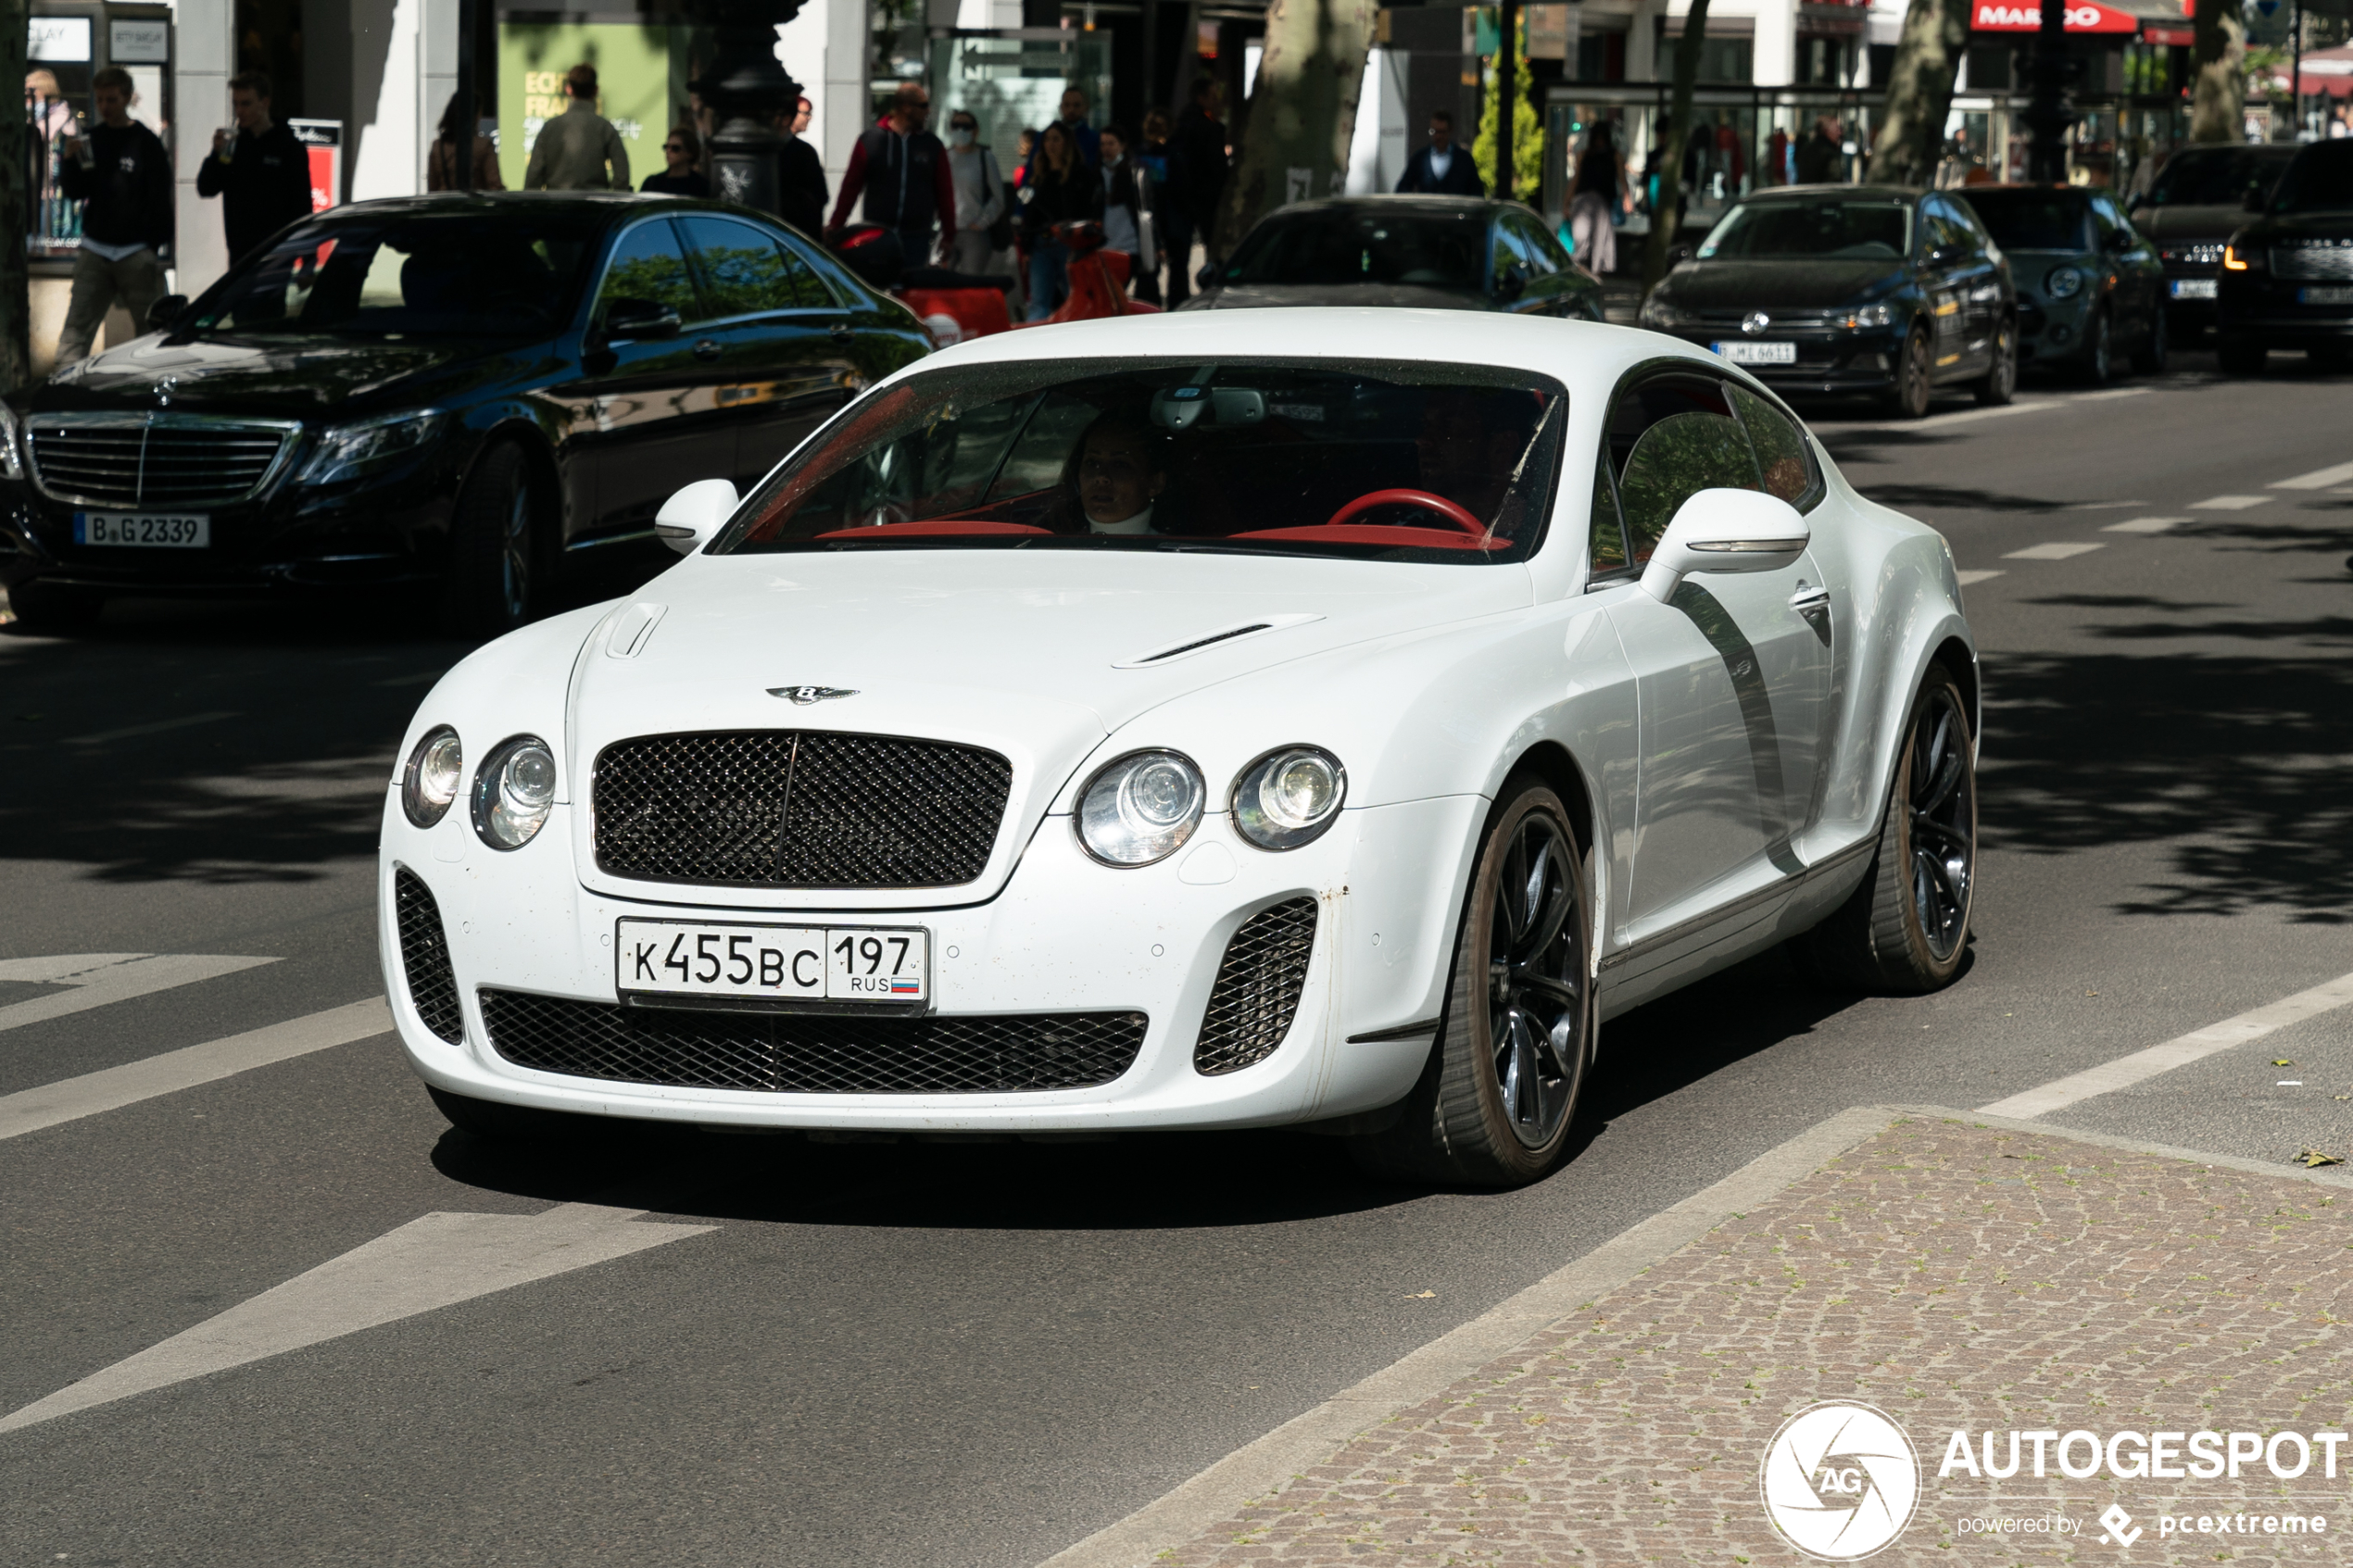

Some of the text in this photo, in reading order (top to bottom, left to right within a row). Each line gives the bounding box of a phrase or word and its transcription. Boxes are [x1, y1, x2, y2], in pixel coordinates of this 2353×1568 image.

[1979, 6, 2100, 26] MARDO
[94, 517, 107, 541] B
[141, 519, 197, 544] 2339
[834, 935, 911, 975] 197
[851, 977, 889, 992] RUS
